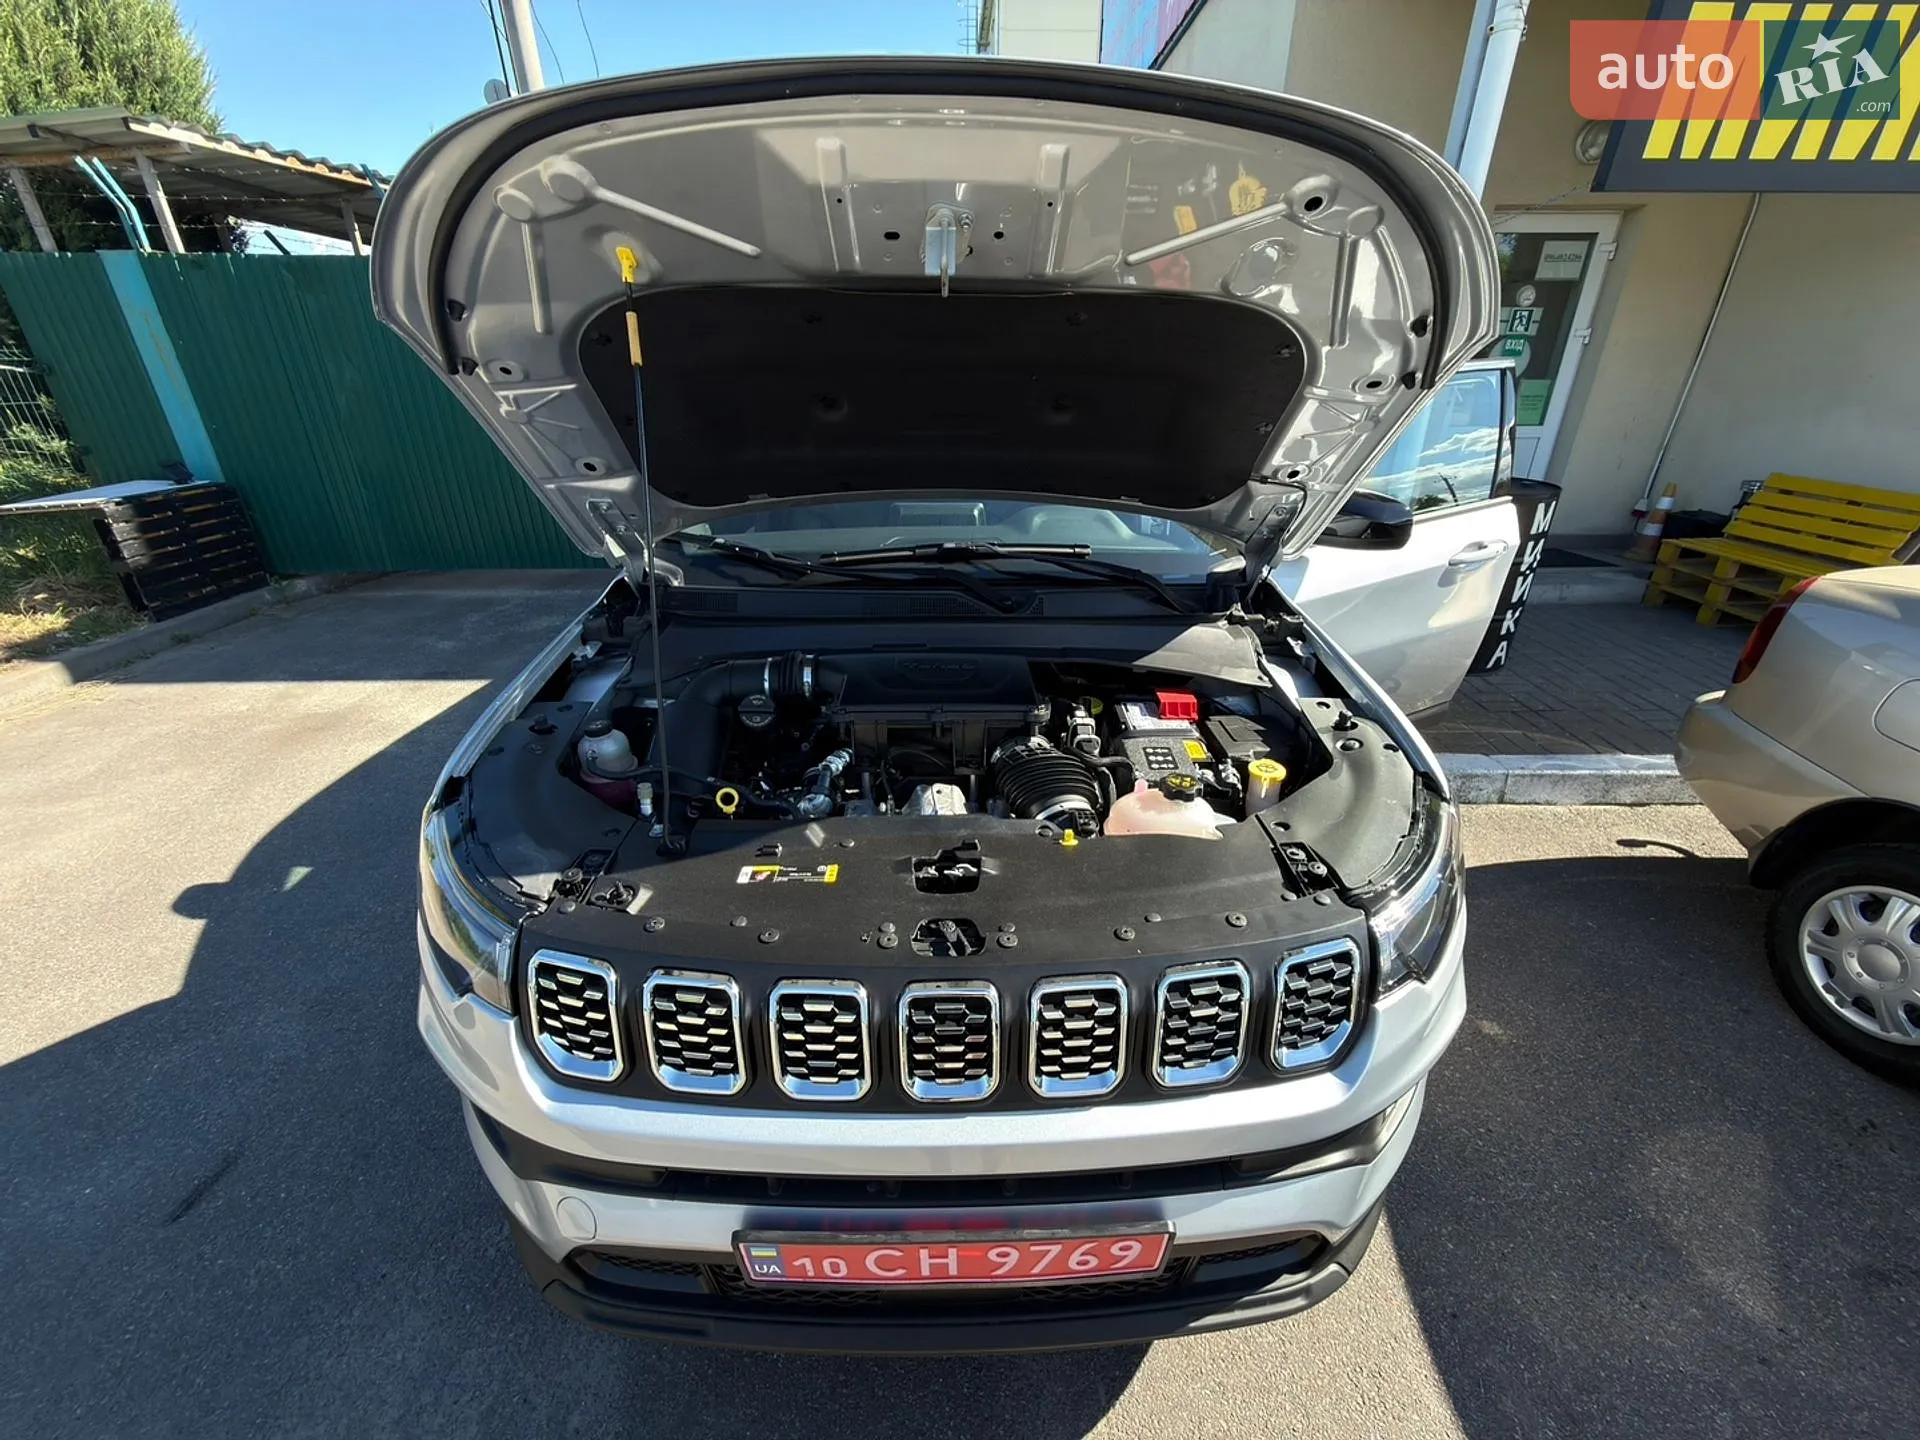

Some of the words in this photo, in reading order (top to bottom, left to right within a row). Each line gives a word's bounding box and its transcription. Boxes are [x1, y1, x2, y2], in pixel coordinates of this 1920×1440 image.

[1486, 500, 1556, 669] МИЙКА
[755, 1264, 781, 1275] UA
[792, 1256, 848, 1277] 10
[986, 1240, 1143, 1275] 9769
